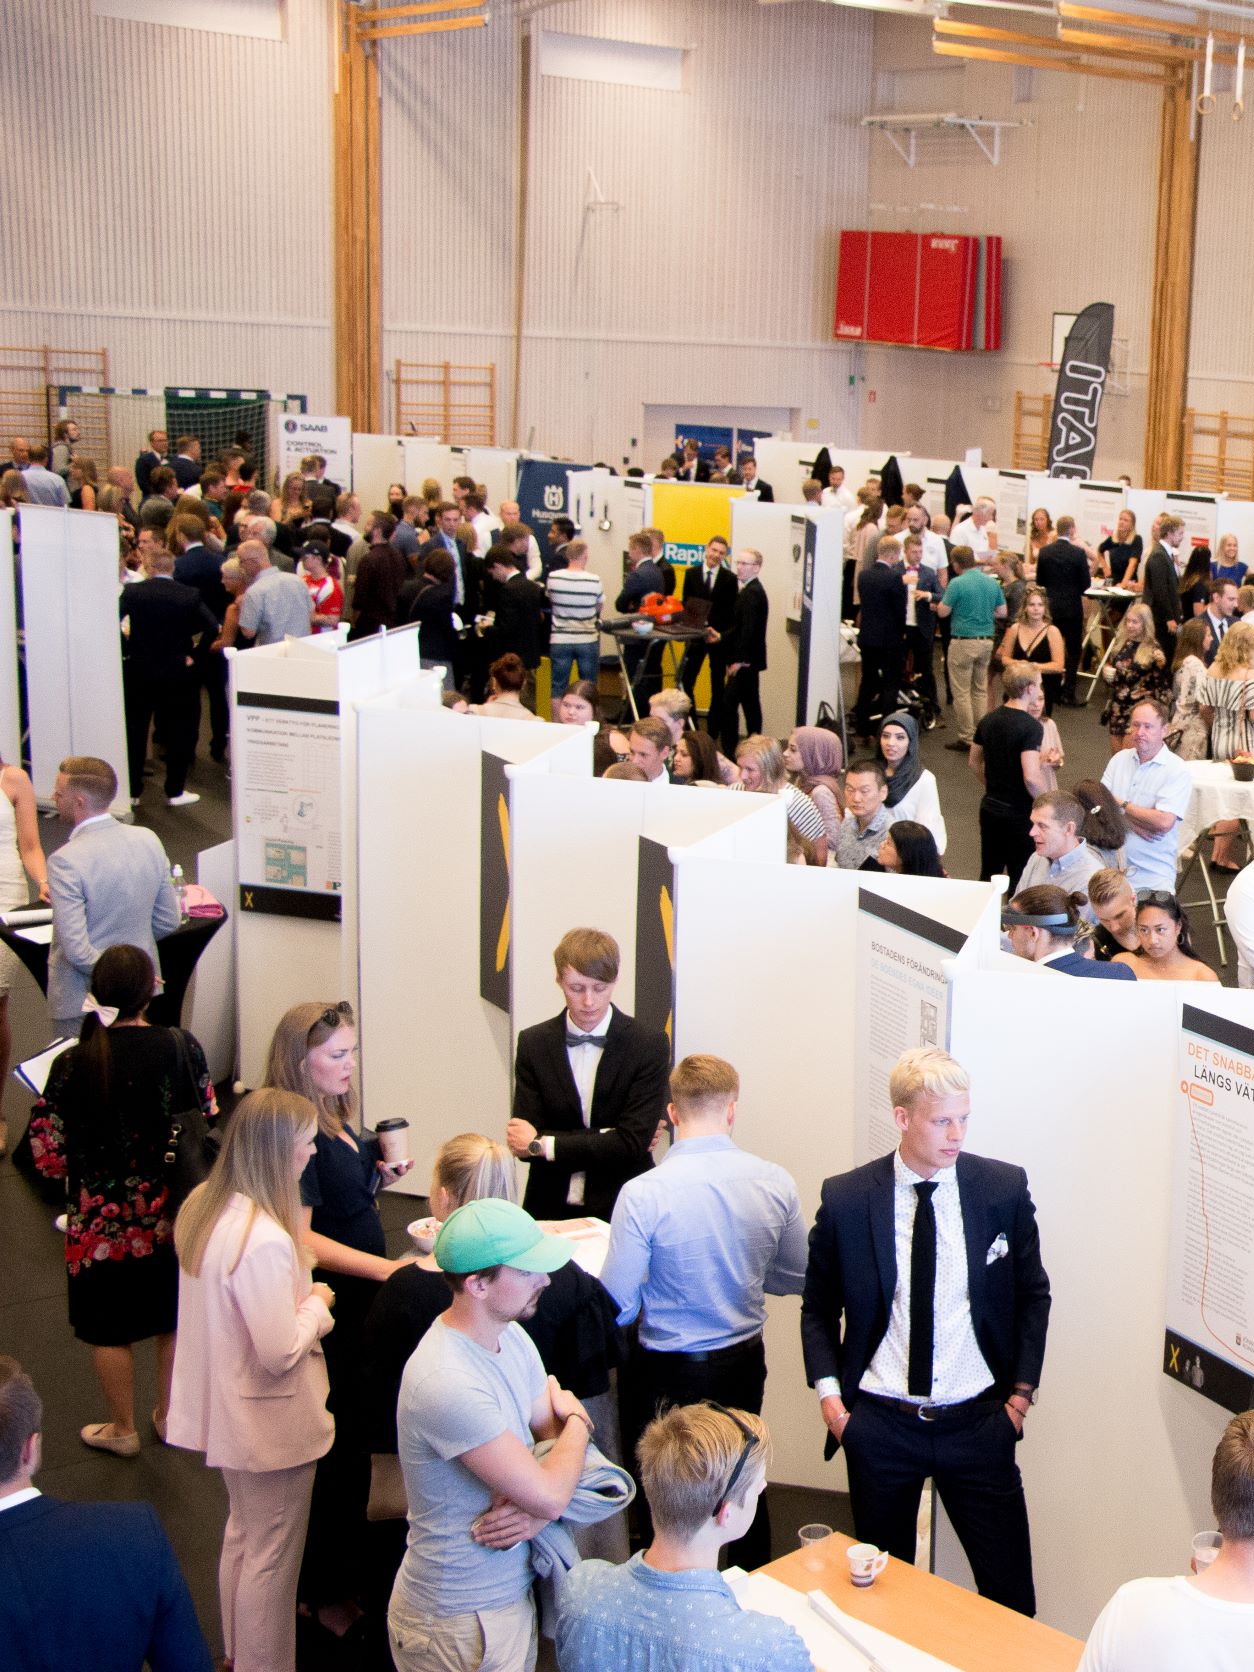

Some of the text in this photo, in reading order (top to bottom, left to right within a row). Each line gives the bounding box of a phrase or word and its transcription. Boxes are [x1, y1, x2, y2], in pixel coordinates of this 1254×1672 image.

[300, 424, 328, 433] SAAB
[1187, 1042, 1210, 1063] DET
[1194, 1064, 1232, 1091] LÄNGS
